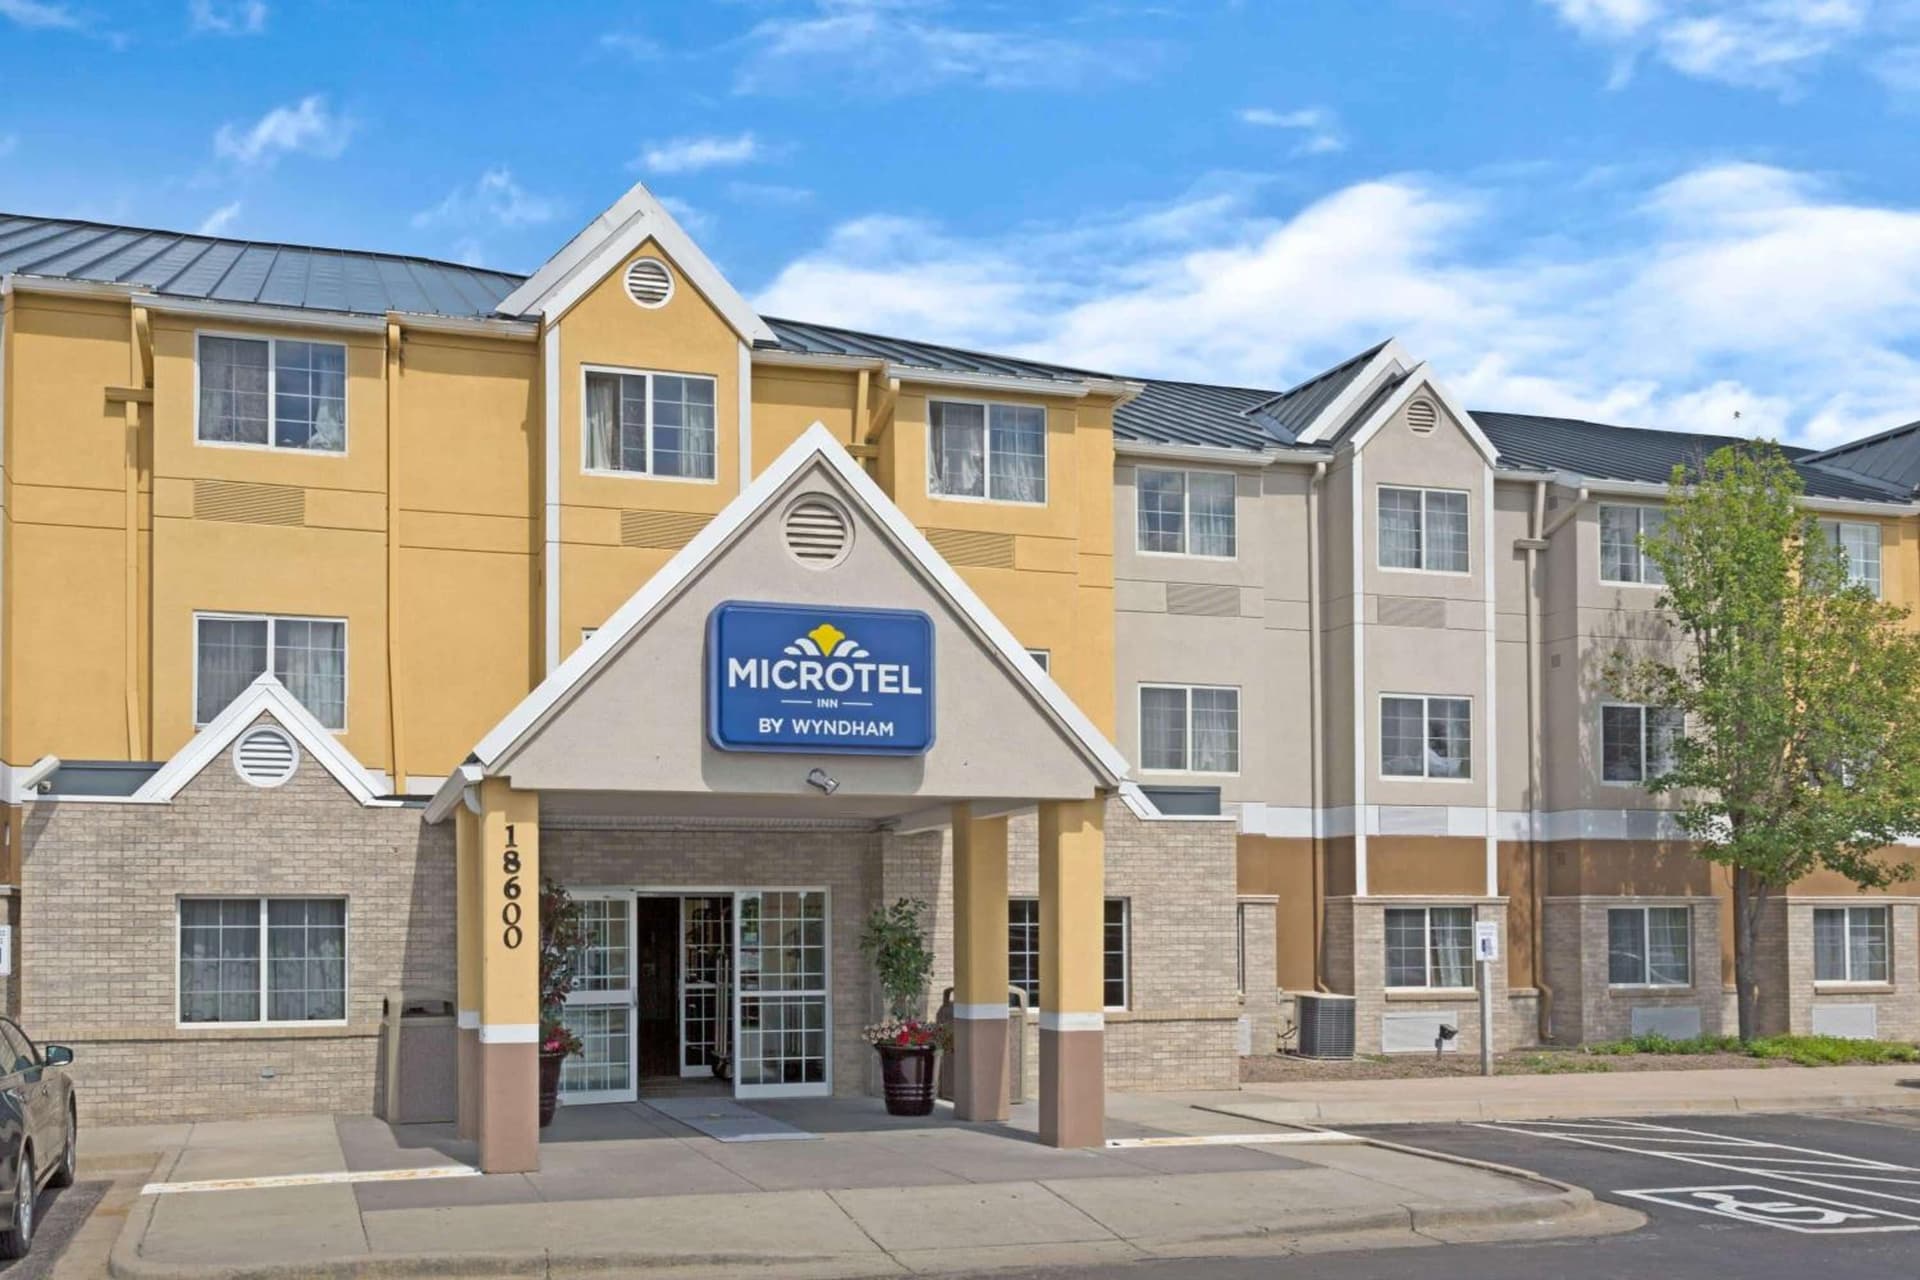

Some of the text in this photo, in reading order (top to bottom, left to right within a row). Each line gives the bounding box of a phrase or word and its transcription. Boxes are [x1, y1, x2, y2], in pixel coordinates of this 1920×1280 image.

[727, 657, 922, 694] MICROTEL
[817, 698, 838, 708] INN
[759, 718, 894, 736] BY WYNDHAM
[502, 824, 523, 949] 18600
